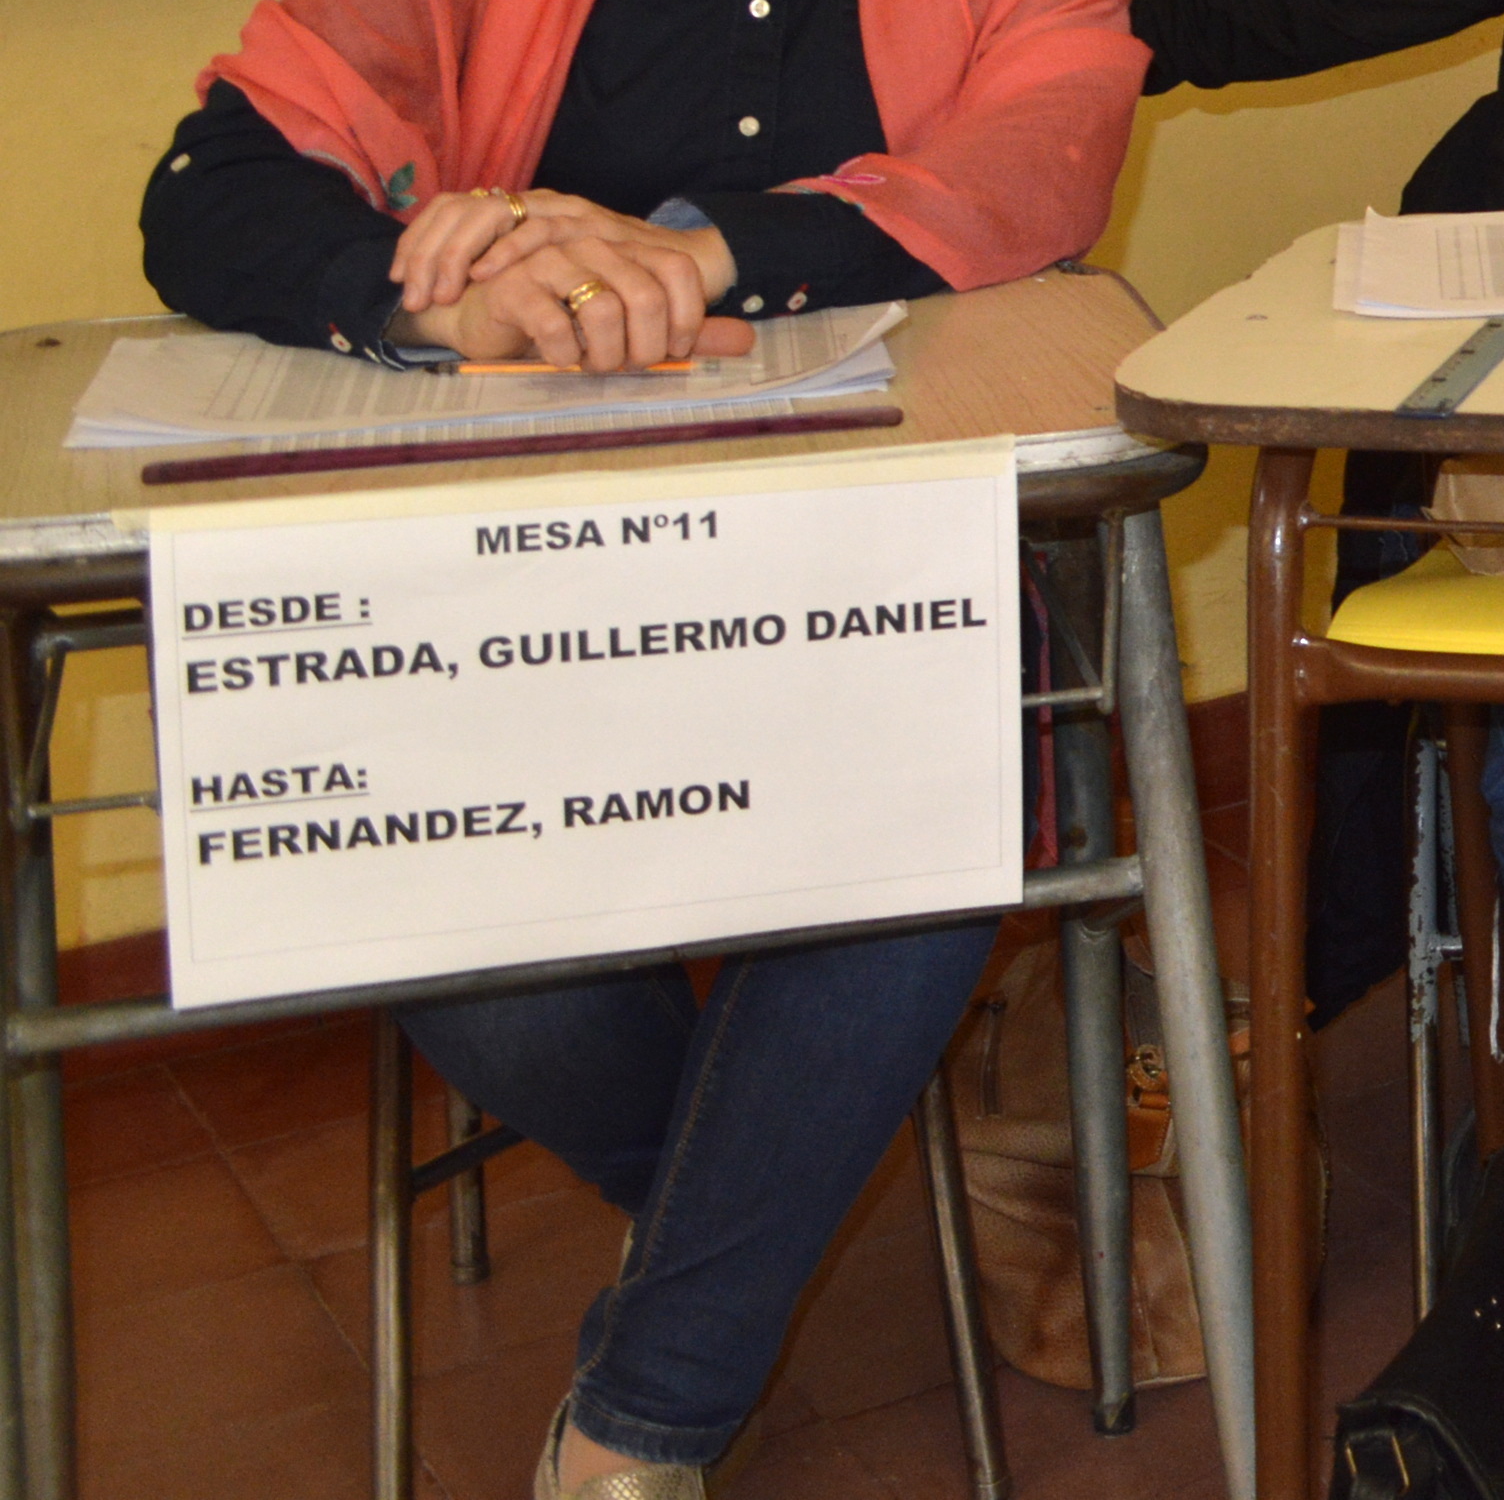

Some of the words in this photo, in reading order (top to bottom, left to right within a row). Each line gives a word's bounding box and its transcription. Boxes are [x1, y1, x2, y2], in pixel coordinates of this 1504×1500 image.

[476, 521, 605, 555] MESA
[183, 593, 341, 633] DESDE
[186, 643, 460, 695] ESTRADA,
[478, 615, 788, 669] GUILLERMO
[806, 596, 989, 642] DANIEL
[191, 765, 370, 806] HASTA:
[198, 803, 545, 866] FERNANDEZ,
[563, 779, 752, 829] RAMON
